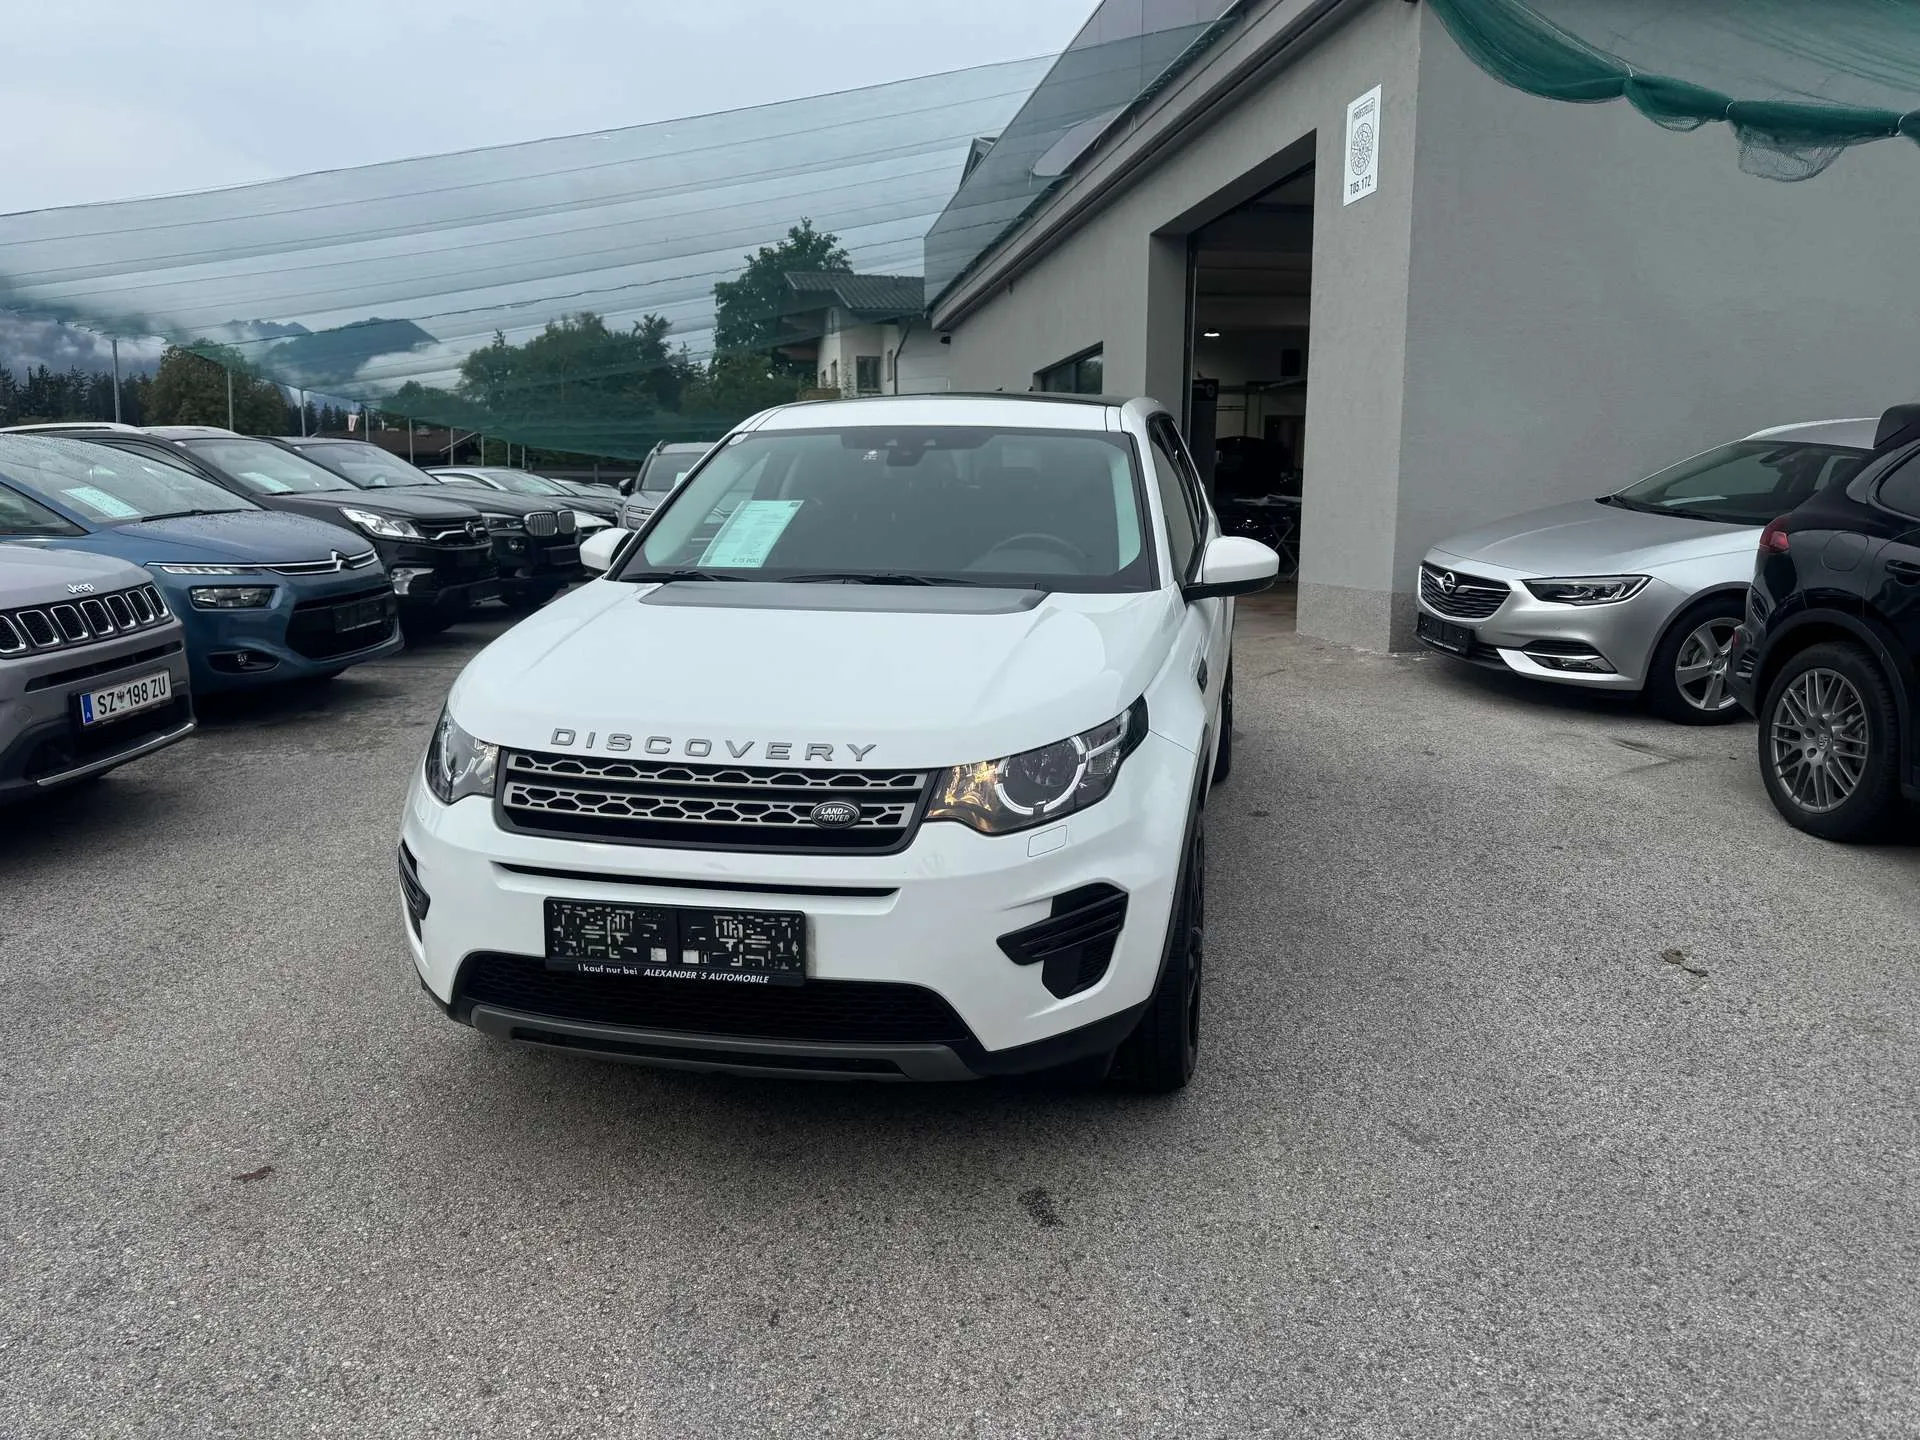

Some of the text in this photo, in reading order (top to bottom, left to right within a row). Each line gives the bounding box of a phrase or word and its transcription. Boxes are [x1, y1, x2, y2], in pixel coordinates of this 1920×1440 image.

[67, 583, 95, 594] Jeep
[97, 676, 166, 715] SZ 198 ZU
[86, 711, 92, 719] A
[550, 727, 877, 762] DISCOVERY
[821, 807, 844, 815] LAND
[822, 814, 850, 822] ROVER
[583, 963, 604, 973] kauf
[606, 966, 621, 975] nur
[623, 966, 638, 976] bei
[708, 972, 770, 984] AUTOMOBILE
